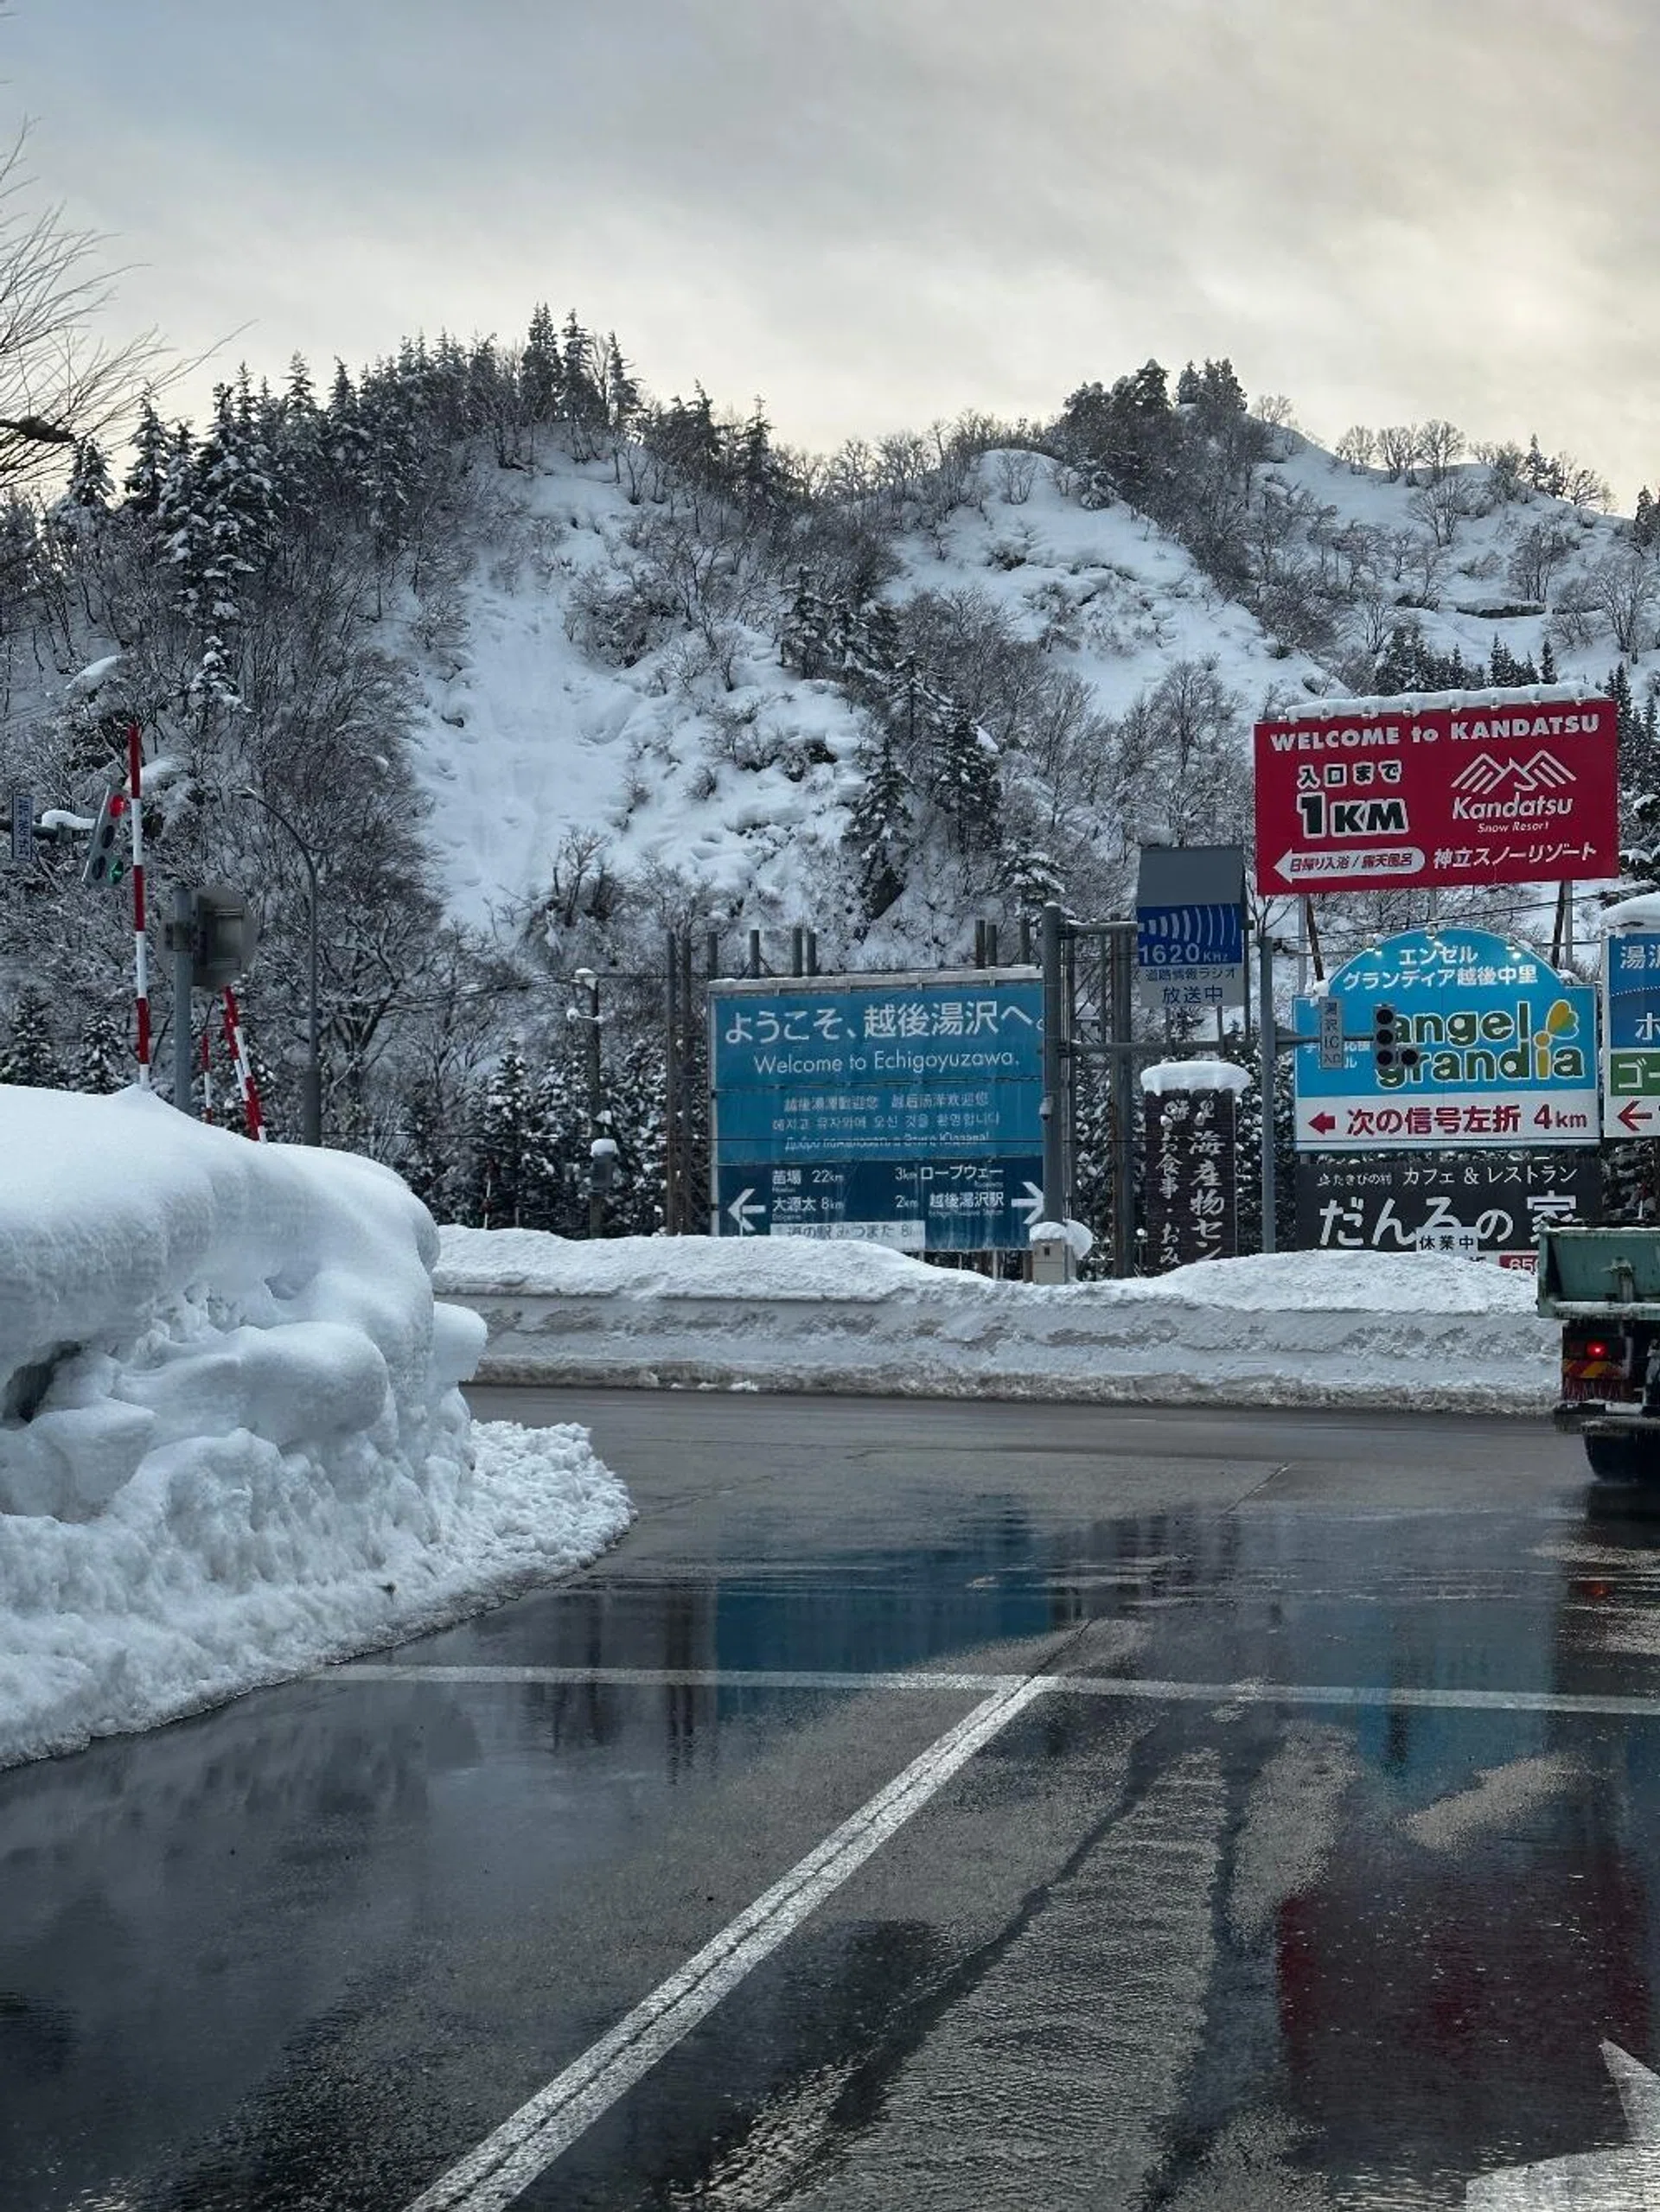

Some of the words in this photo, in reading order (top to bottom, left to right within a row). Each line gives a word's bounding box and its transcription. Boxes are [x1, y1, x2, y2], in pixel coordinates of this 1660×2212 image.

[1270, 727, 1400, 751] WELCOME
[1411, 726, 1439, 743] to
[1451, 714, 1599, 741] KANDATSU
[1297, 761, 1402, 790] 入口まで
[1452, 791, 1574, 820] Kandatsu
[1478, 822, 1510, 833] Snow
[1513, 821, 1550, 832] Resort
[1433, 842, 1598, 870] 神立スノーリゾート
[1139, 943, 1200, 964] 1620
[1397, 945, 1478, 966] エンゼル
[1343, 965, 1539, 991] グランディア越後中里
[1162, 986, 1223, 1004] 放送中
[754, 1055, 843, 1075] Welcome
[850, 1053, 866, 1070] to
[874, 1049, 1020, 1074] Echigoyuzawa.
[1346, 1106, 1521, 1138] 次の信号左折
[1533, 1103, 1587, 1131] 4km
[771, 1170, 801, 1185] 苗場
[1401, 1166, 1456, 1185] カフェ
[1463, 1167, 1479, 1184] &
[1487, 1165, 1579, 1184] レストラン
[772, 1196, 817, 1212] 大源太
[929, 1192, 1004, 1208] 越後湯沢駅
[1419, 1234, 1475, 1251] 休業中
